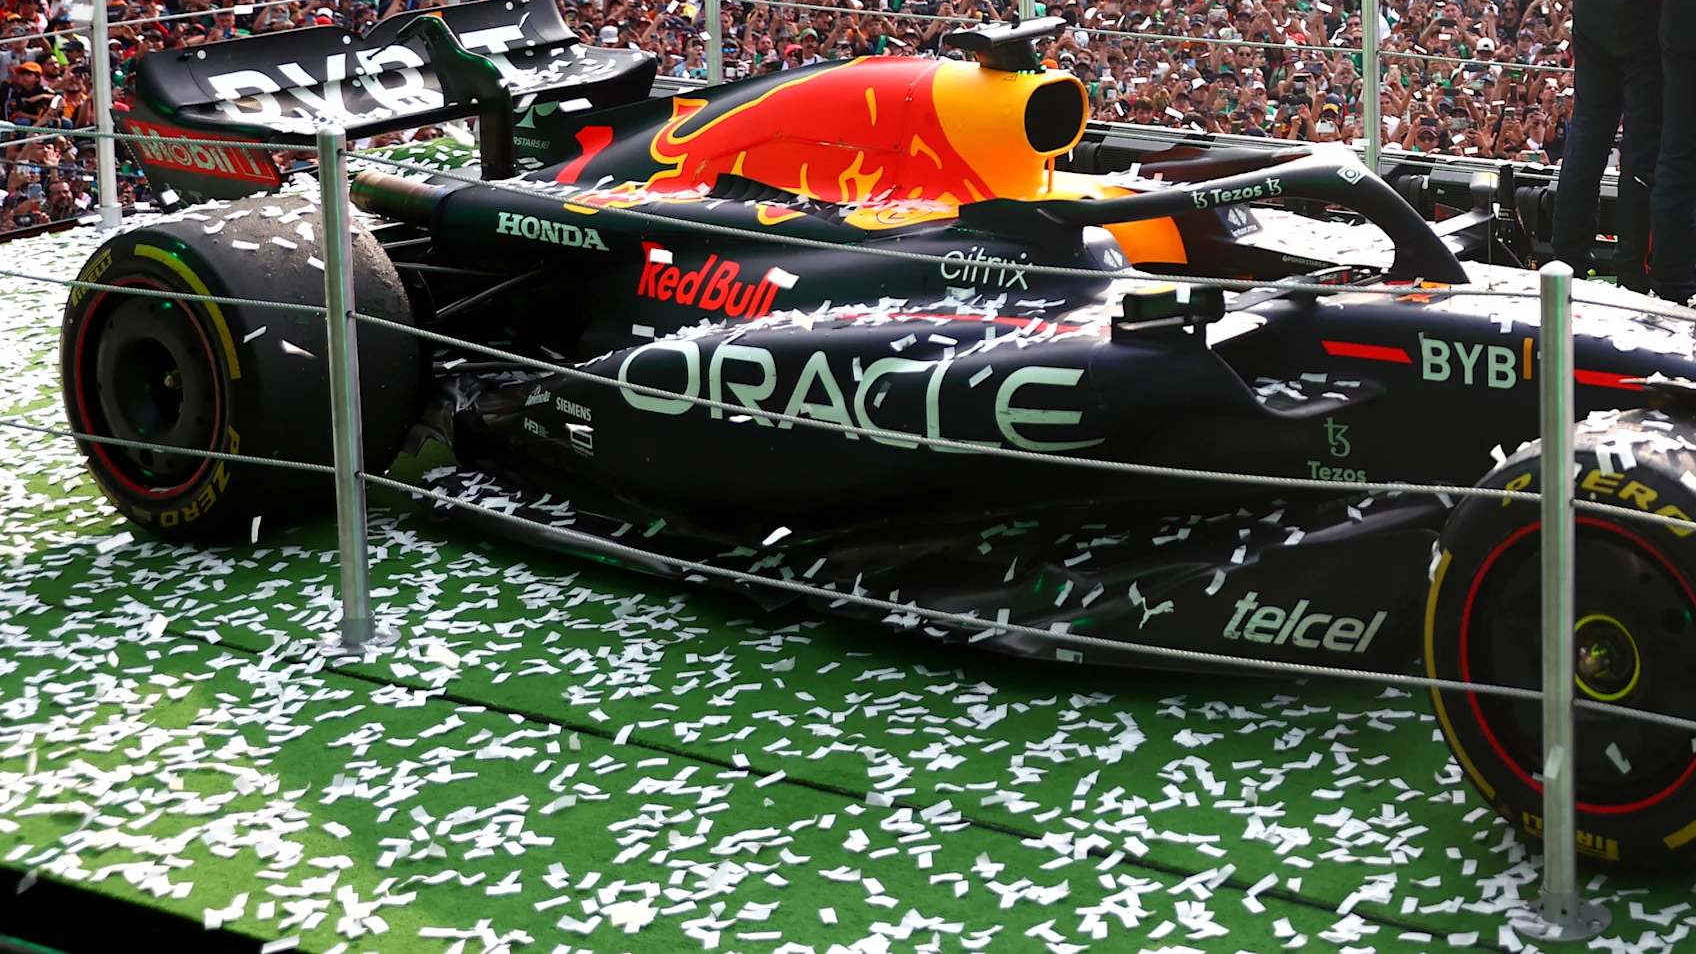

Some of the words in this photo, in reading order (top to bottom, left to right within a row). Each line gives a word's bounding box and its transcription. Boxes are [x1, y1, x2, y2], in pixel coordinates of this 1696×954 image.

[207, 24, 532, 128] BYBT
[130, 125, 237, 174] Mobil
[1210, 184, 1263, 204] Tezos
[497, 211, 610, 251] HONDA
[1421, 337, 1541, 389] BYBI
[556, 396, 592, 422] SIEMENS
[617, 340, 1106, 453] ORACLE
[227, 425, 240, 456] P
[159, 461, 232, 528] ZERO
[1308, 461, 1367, 483] Tezos
[1502, 473, 1531, 507] P
[1580, 469, 1694, 538] ERO
[1223, 591, 1388, 653] telcel
